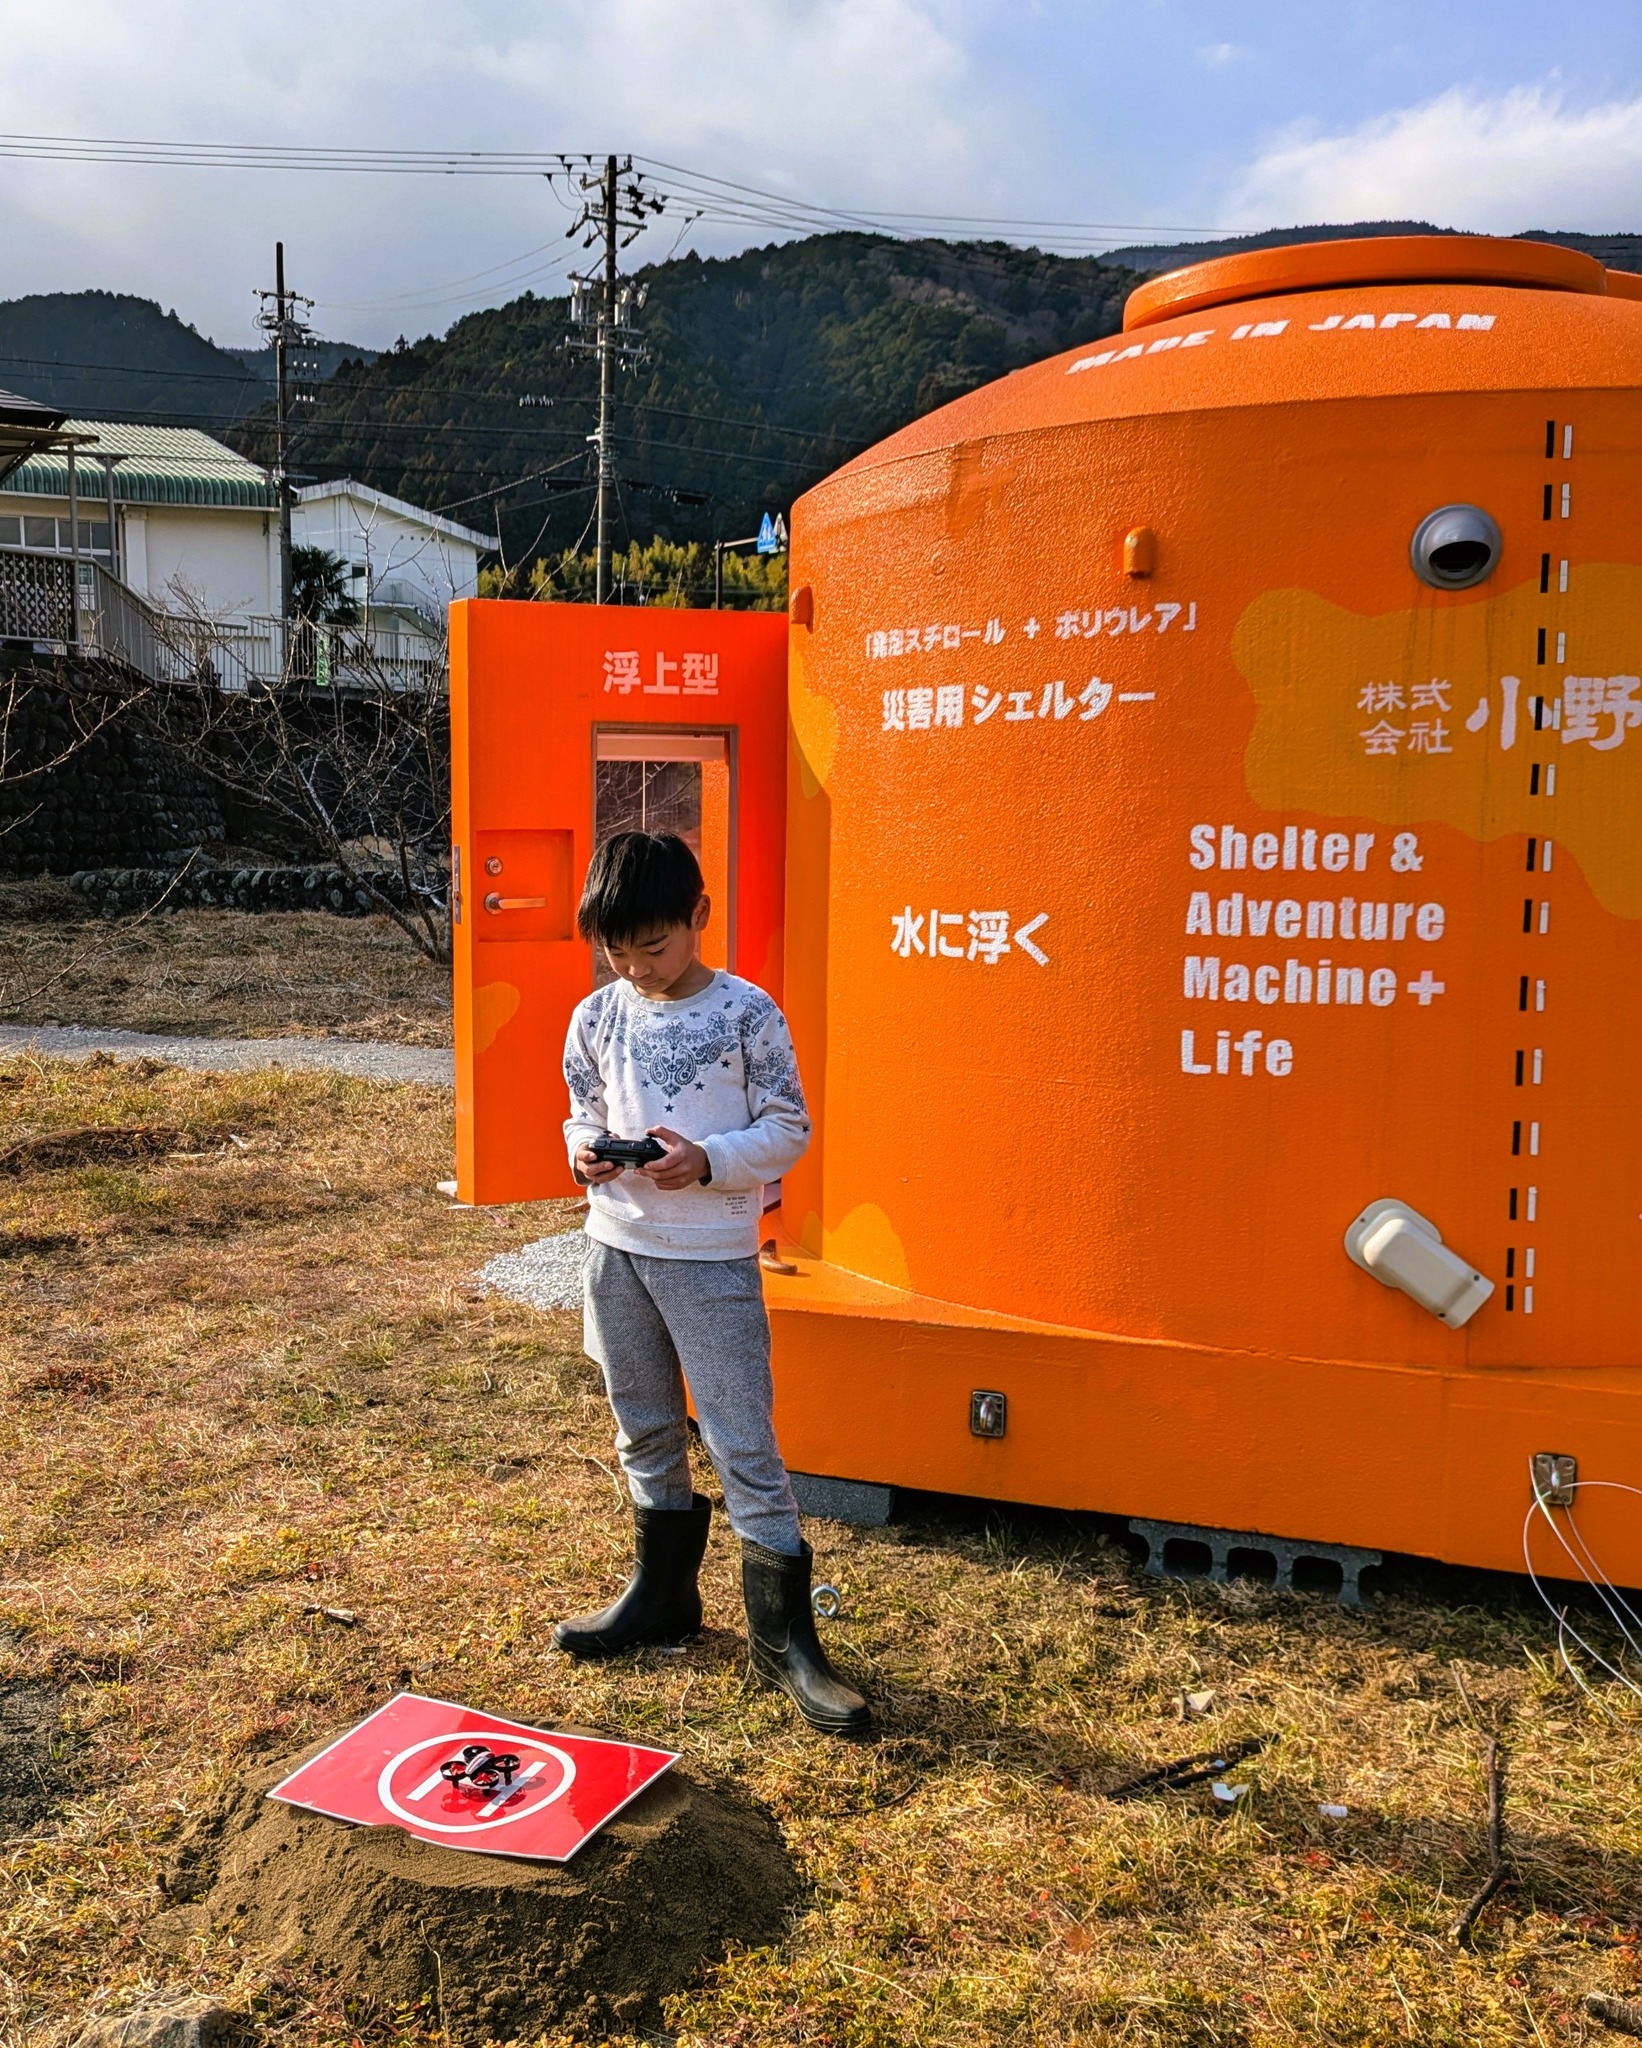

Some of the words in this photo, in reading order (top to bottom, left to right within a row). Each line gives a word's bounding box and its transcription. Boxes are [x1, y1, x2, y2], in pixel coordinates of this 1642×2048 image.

[1065, 329, 1215, 375] MADE
[1231, 319, 1290, 340] IN
[1308, 313, 1497, 331] JAPAN
[602, 651, 719, 694] 浮上型
[1357, 678, 1452, 714] 株式
[1359, 719, 1454, 755] 会社
[1189, 824, 1375, 872] Shelter
[1390, 832, 1424, 872] &
[890, 905, 1050, 967] 水に浮く
[1185, 891, 1445, 941] Adventure
[1183, 956, 1397, 1007] Machine
[1181, 1029, 1293, 1077] Life
